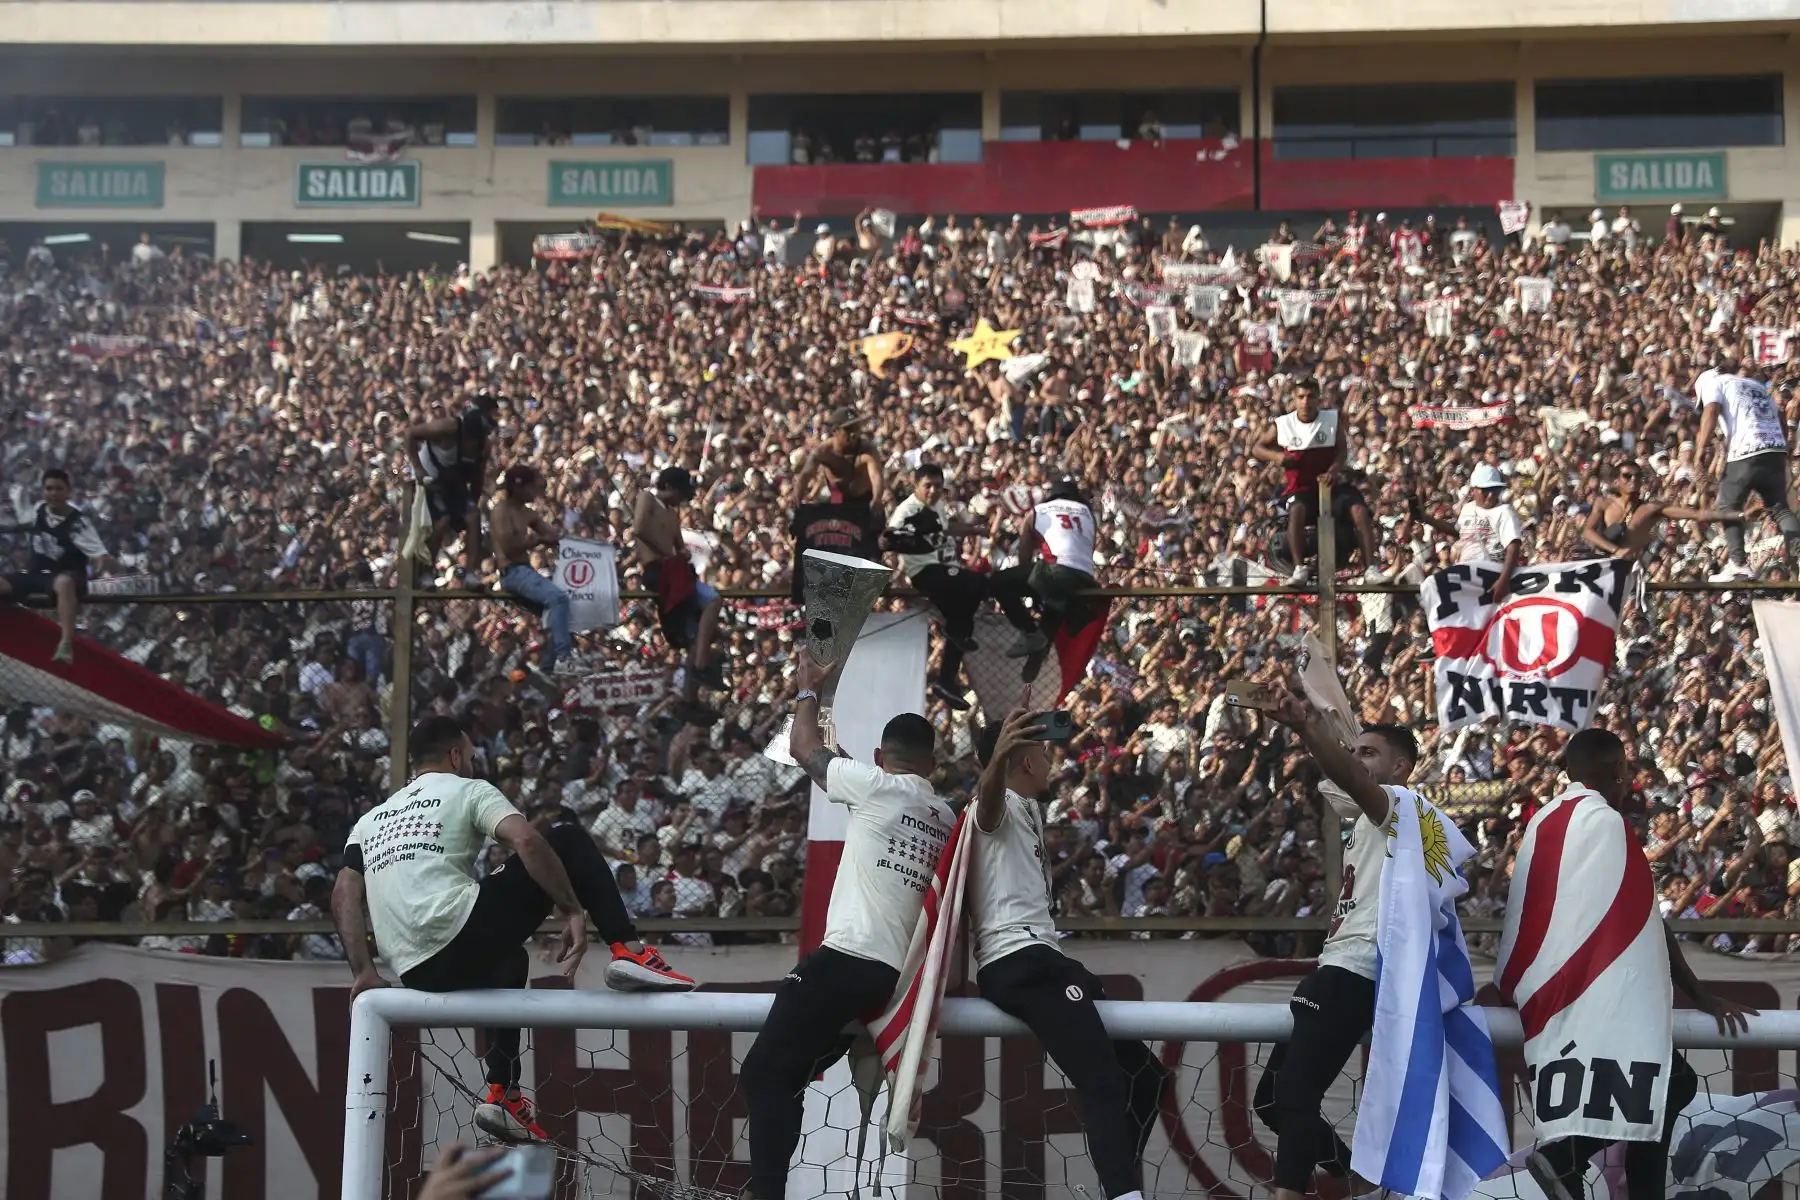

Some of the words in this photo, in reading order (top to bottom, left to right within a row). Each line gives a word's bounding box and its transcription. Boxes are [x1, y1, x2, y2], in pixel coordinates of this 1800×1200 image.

[50, 169, 150, 197] SALIDA
[307, 168, 408, 198] SALIDA
[561, 168, 660, 196] SALIDA
[1609, 160, 1714, 191] SALIDA
[1056, 514, 1083, 534] 31
[570, 564, 588, 584] U
[1502, 611, 1560, 671] U
[373, 798, 442, 822] marathon
[893, 863, 919, 879] CLUB
[903, 877, 909, 886] Y
